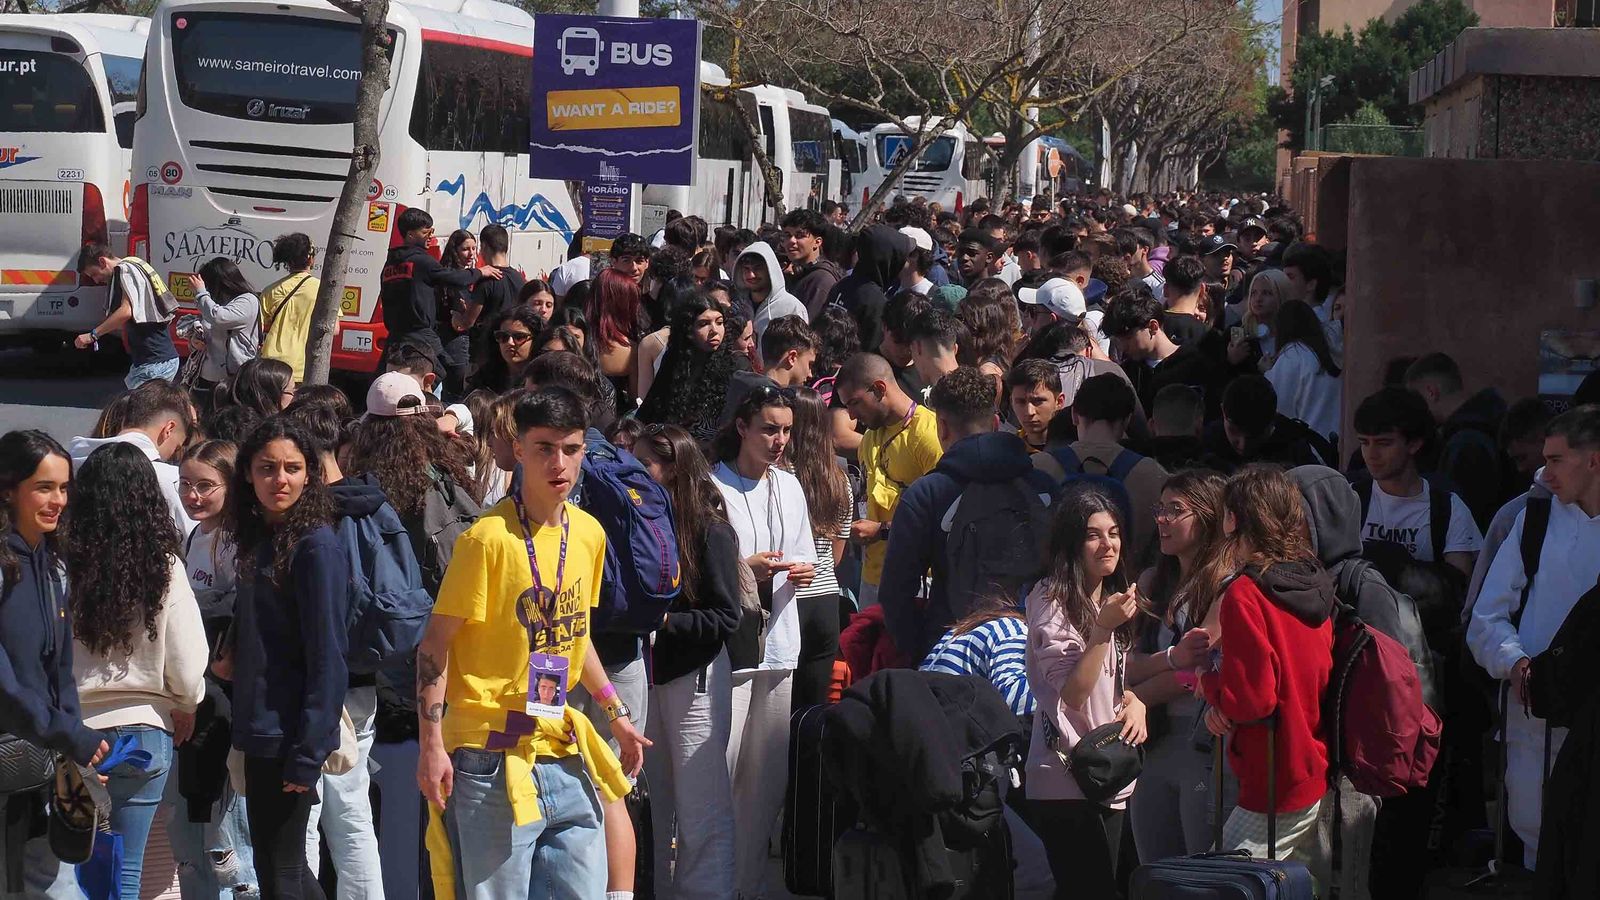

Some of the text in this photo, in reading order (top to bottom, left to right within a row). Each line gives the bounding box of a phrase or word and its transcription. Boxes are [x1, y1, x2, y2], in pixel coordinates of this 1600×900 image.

[611, 42, 673, 66] BUS
[198, 57, 362, 80] www.sameirotravel.com
[552, 101, 676, 118] WANT A RIDE?
[60, 170, 80, 178] 2231
[148, 169, 158, 177] 05
[165, 168, 178, 177] 80
[385, 188, 396, 197] 05
[163, 231, 275, 269] SAMEIRO
[49, 300, 63, 310] TP
[356, 336, 372, 346] TP
[1367, 522, 1419, 543] TOMMY
